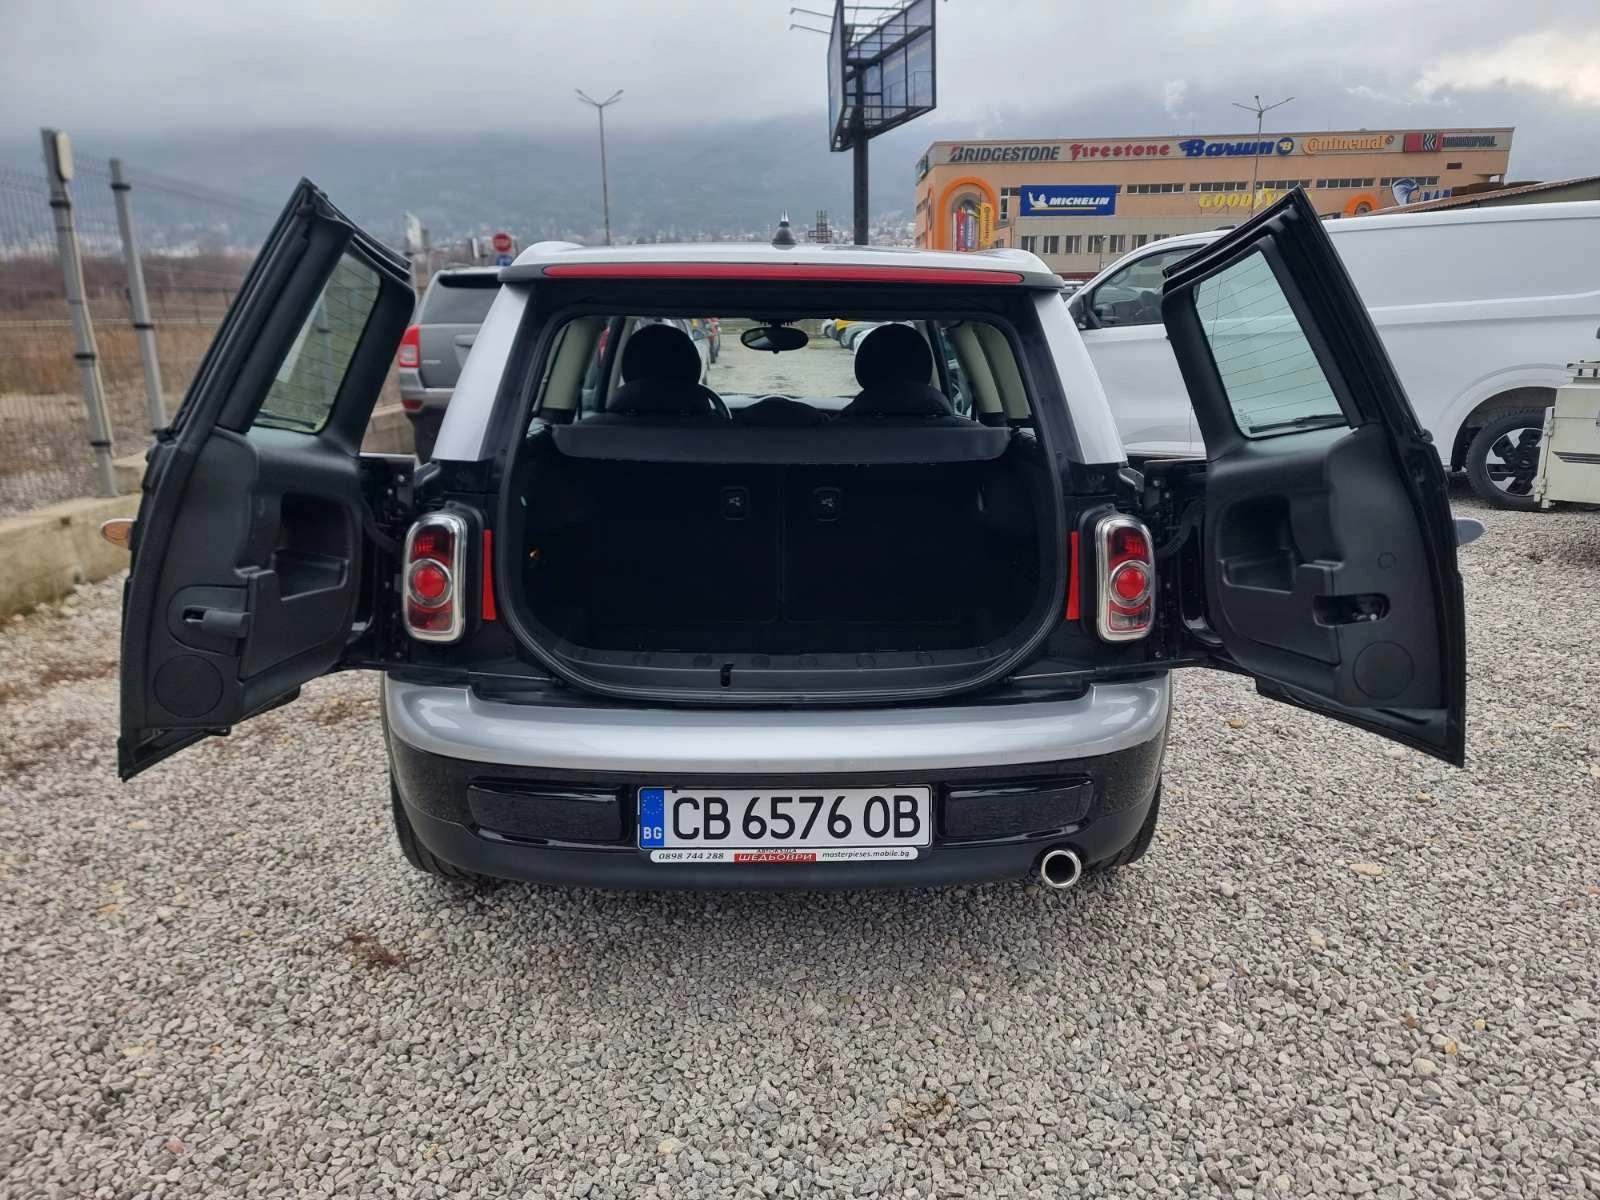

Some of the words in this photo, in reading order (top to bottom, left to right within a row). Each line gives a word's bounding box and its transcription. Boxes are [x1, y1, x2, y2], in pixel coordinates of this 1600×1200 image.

[950, 144, 1061, 162] BRIDGESTONE
[1070, 143, 1170, 160] Firestone
[1178, 139, 1275, 157] Barum
[1049, 197, 1110, 206] MICHELIN
[1199, 188, 1310, 209] GOODY
[672, 797, 731, 840] CB
[742, 796, 852, 840] 6576
[863, 795, 921, 839] OB
[643, 827, 663, 840] BG
[659, 852, 683, 860] 0898
[686, 852, 704, 860] 744
[706, 852, 725, 860] 288
